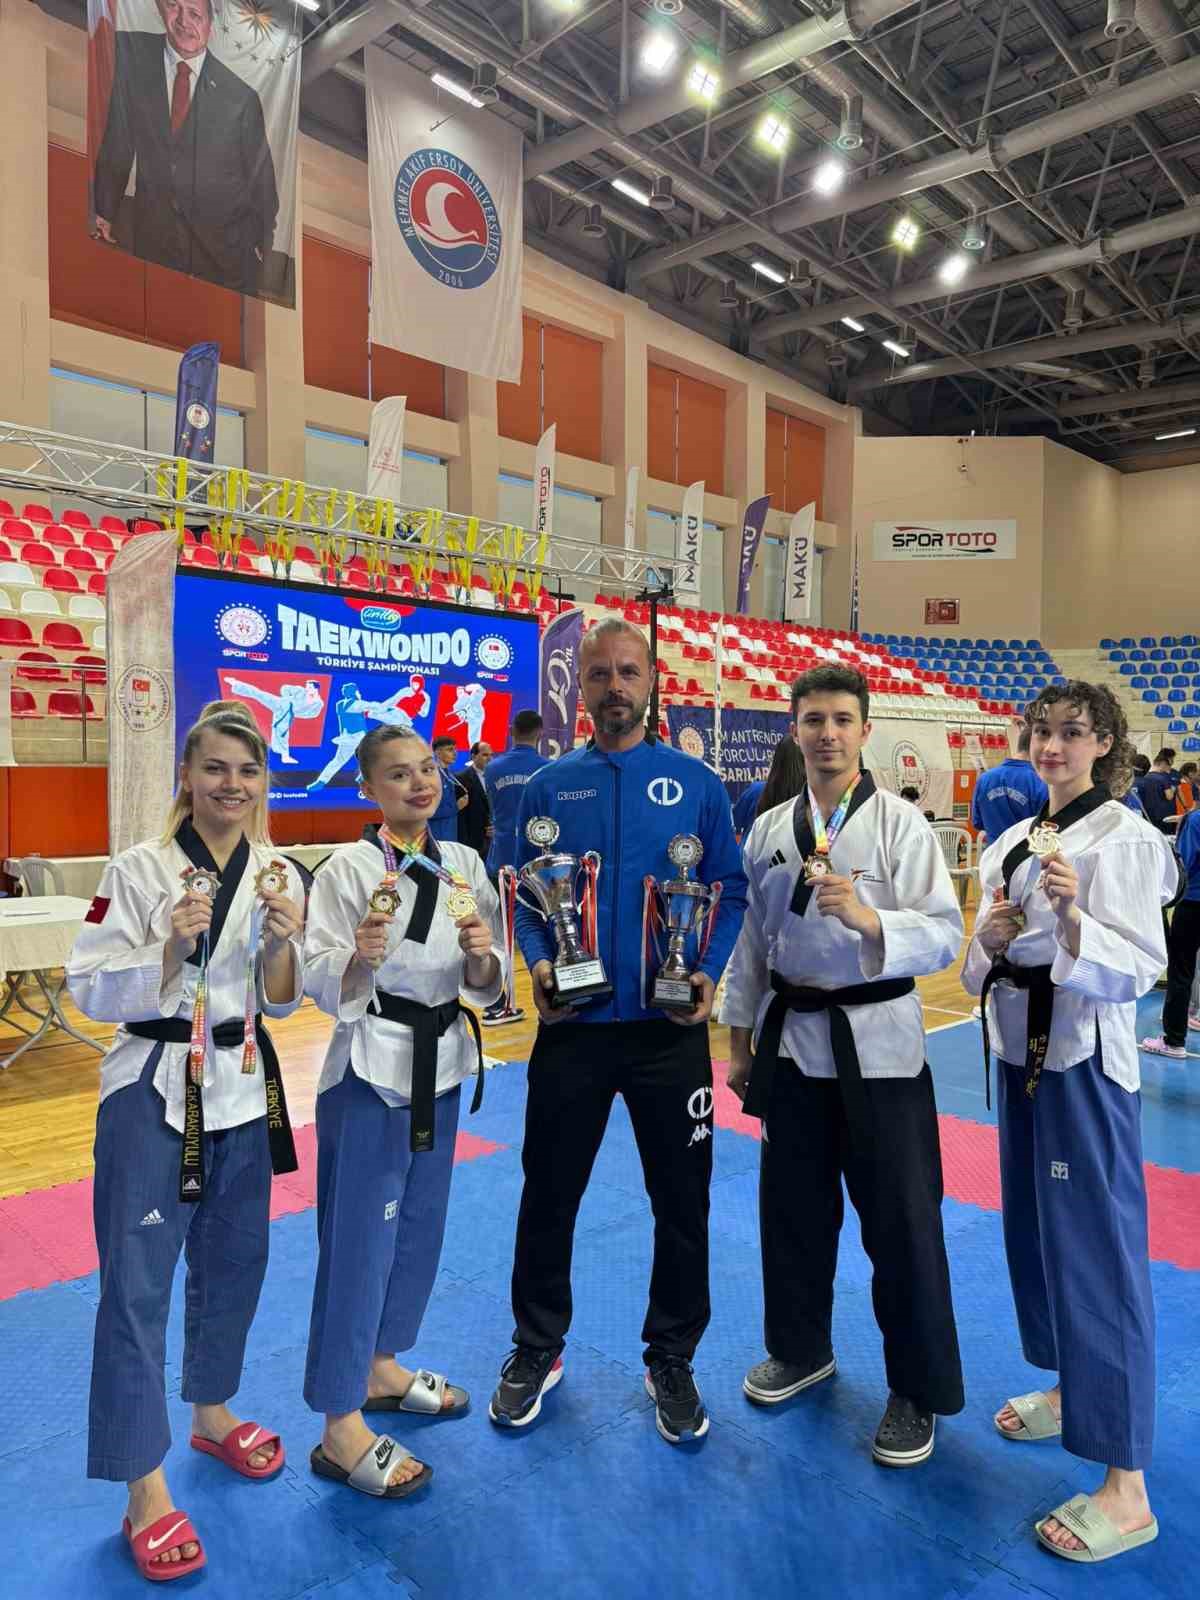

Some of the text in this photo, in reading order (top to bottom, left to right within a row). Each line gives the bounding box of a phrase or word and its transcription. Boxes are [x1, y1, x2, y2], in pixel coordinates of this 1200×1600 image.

[428, 152, 464, 175] ERSOY
[892, 532, 997, 547] SPOR TOTO
[793, 537, 808, 599] MAKÜ
[277, 603, 470, 667] TAEKWONDO
[316, 656, 439, 676] TÜRKİYE ŞAMPİYONASI
[557, 789, 597, 800] Kappa
